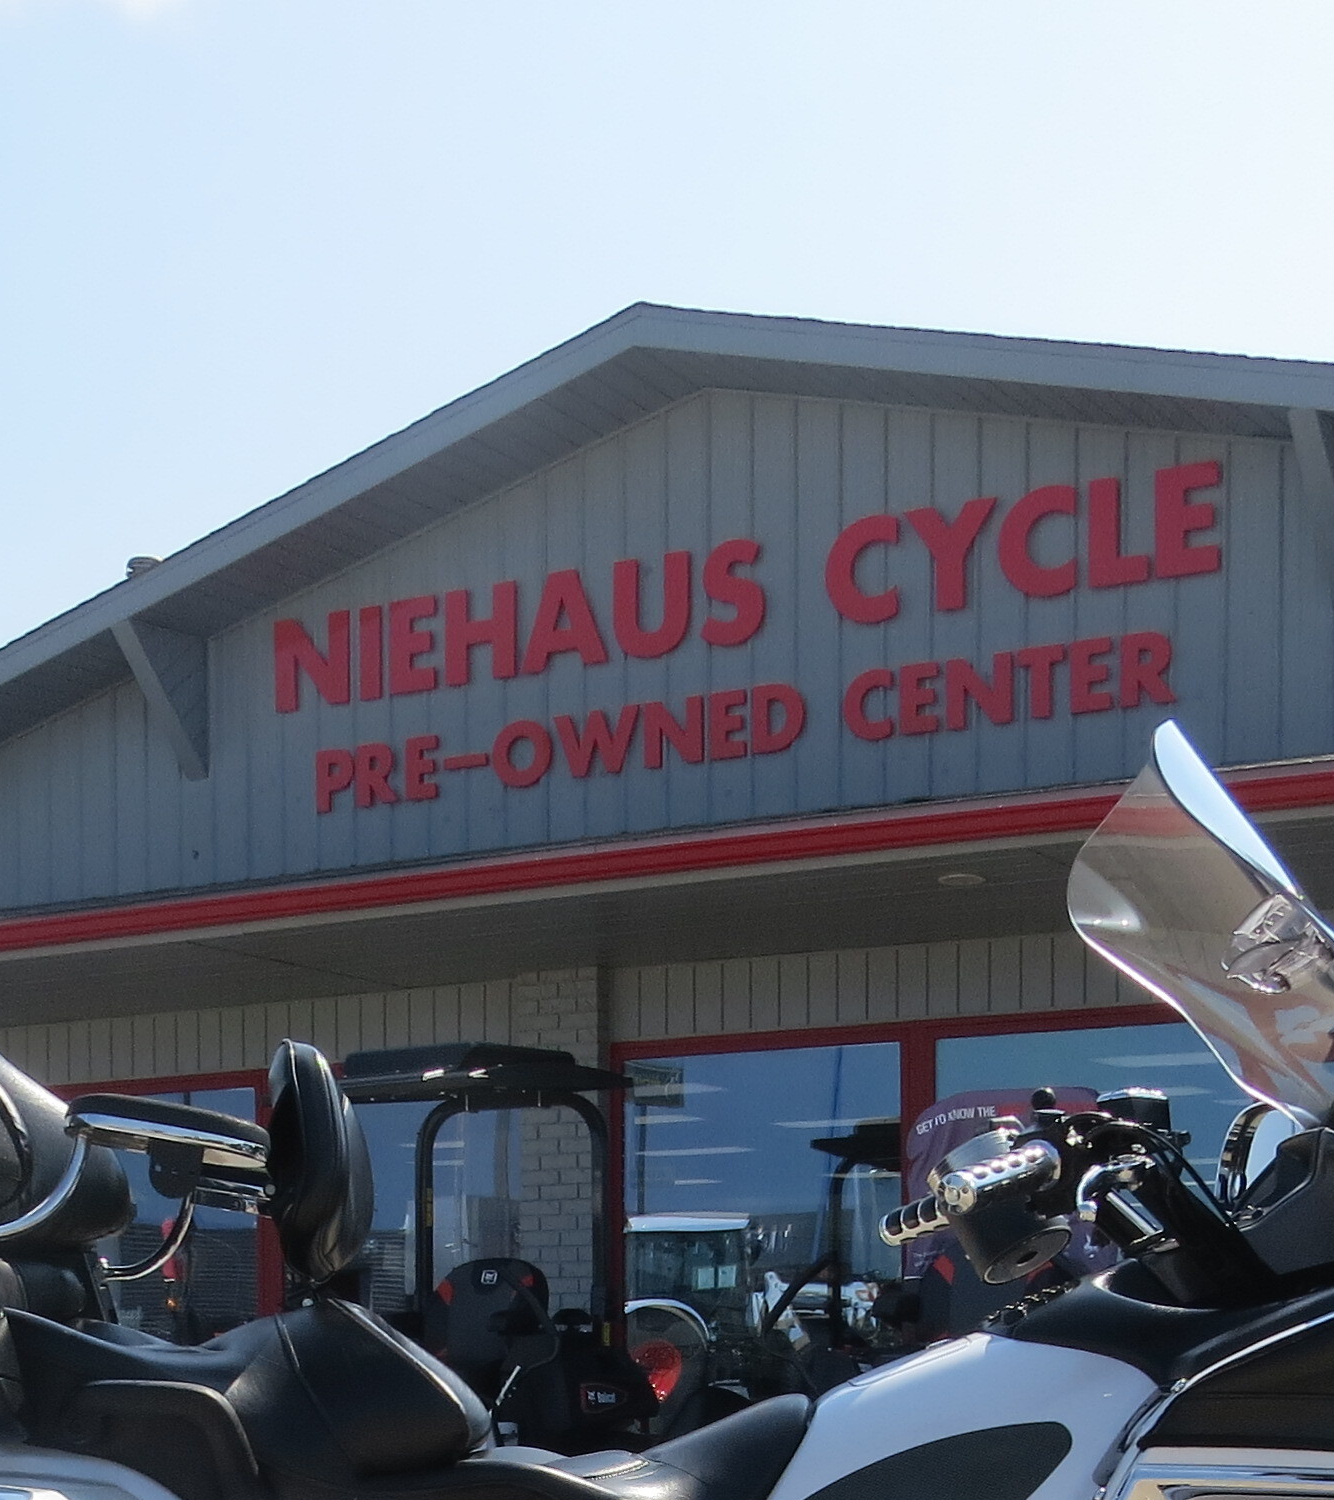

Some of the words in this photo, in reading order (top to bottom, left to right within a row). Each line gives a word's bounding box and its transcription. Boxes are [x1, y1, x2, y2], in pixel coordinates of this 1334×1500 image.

[274, 539, 766, 714] NIEHAUS
[825, 460, 1223, 625] CYCLE
[315, 682, 807, 815] PRE-OWNED
[842, 631, 1177, 741] CENTER
[916, 1120, 933, 1135] GET
[977, 1105, 997, 1118] THE
